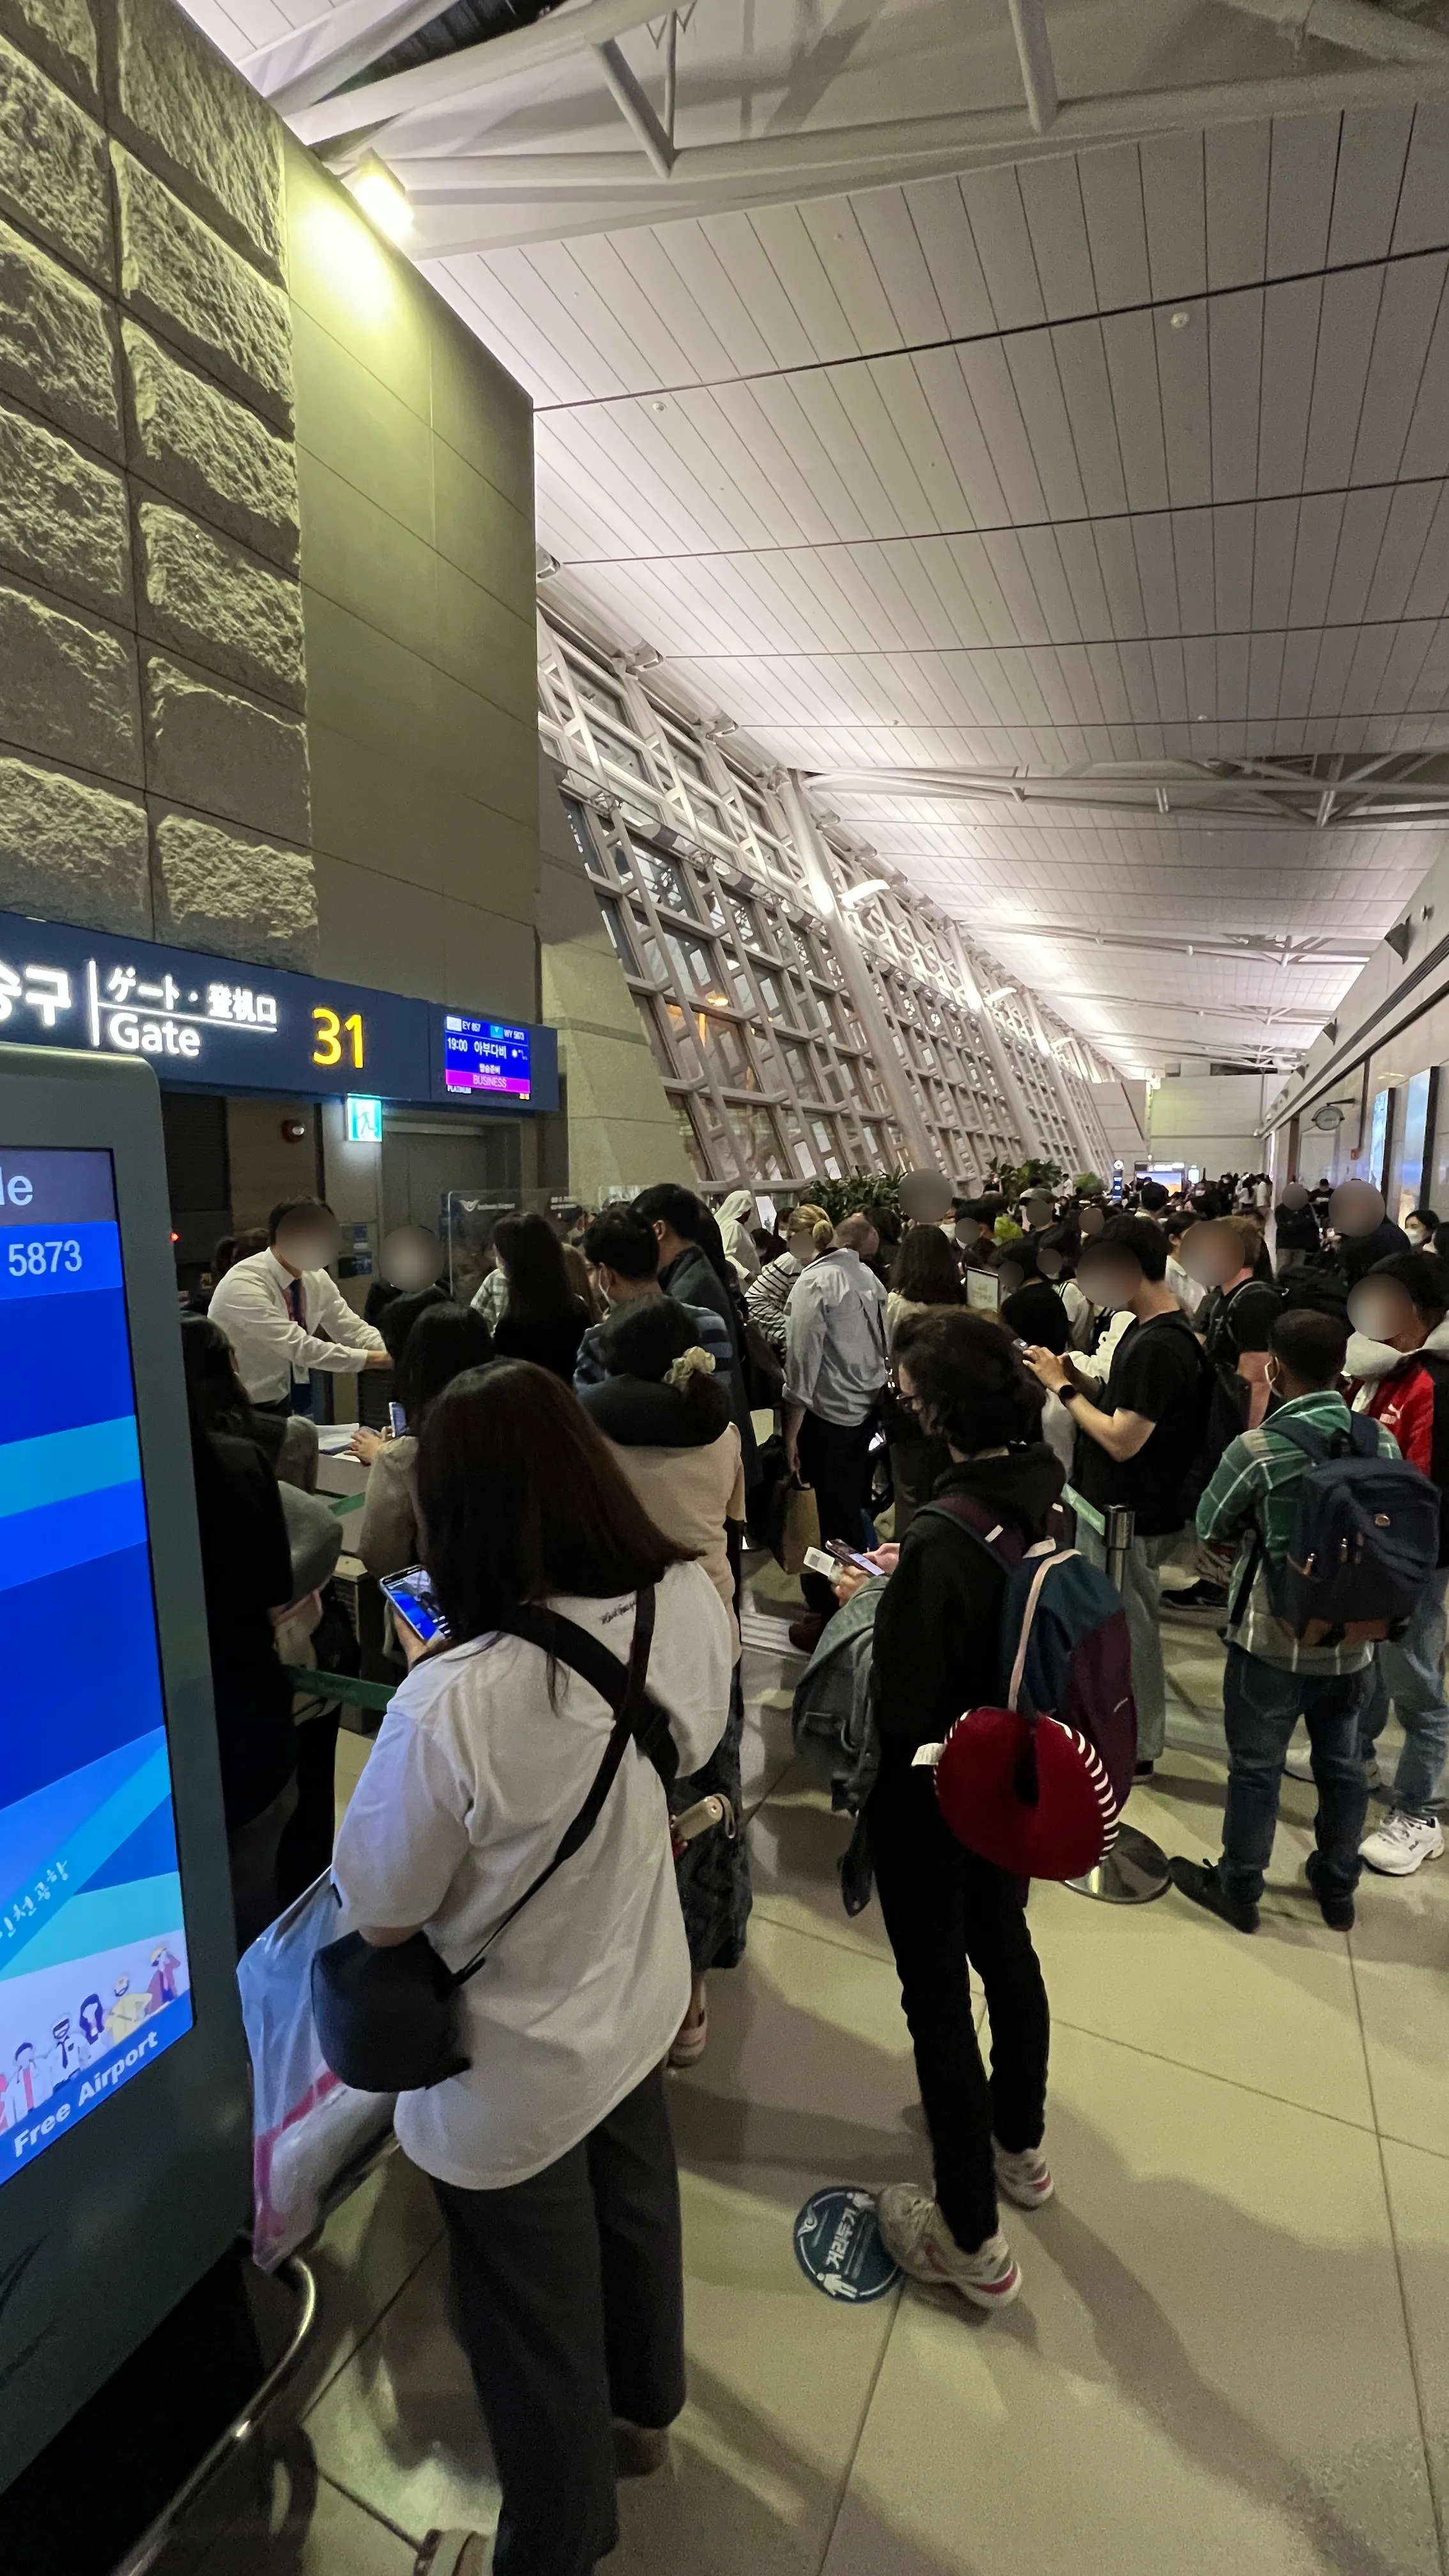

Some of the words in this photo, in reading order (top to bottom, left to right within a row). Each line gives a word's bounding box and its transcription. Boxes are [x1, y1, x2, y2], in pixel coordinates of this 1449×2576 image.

[109, 1013, 201, 1056] Gate
[312, 1007, 364, 1068] 31
[462, 1021, 471, 1031] EY
[503, 1029, 513, 1038] WY
[447, 1037, 468, 1052] 19:00
[473, 1040, 507, 1060] 아부다비
[473, 1074, 507, 1089] BUSINESS
[8, 1240, 82, 1276] 5873
[14, 2103, 71, 2158] Free
[79, 2031, 158, 2106] Airport
[824, 2207, 860, 2269] 거리두기
